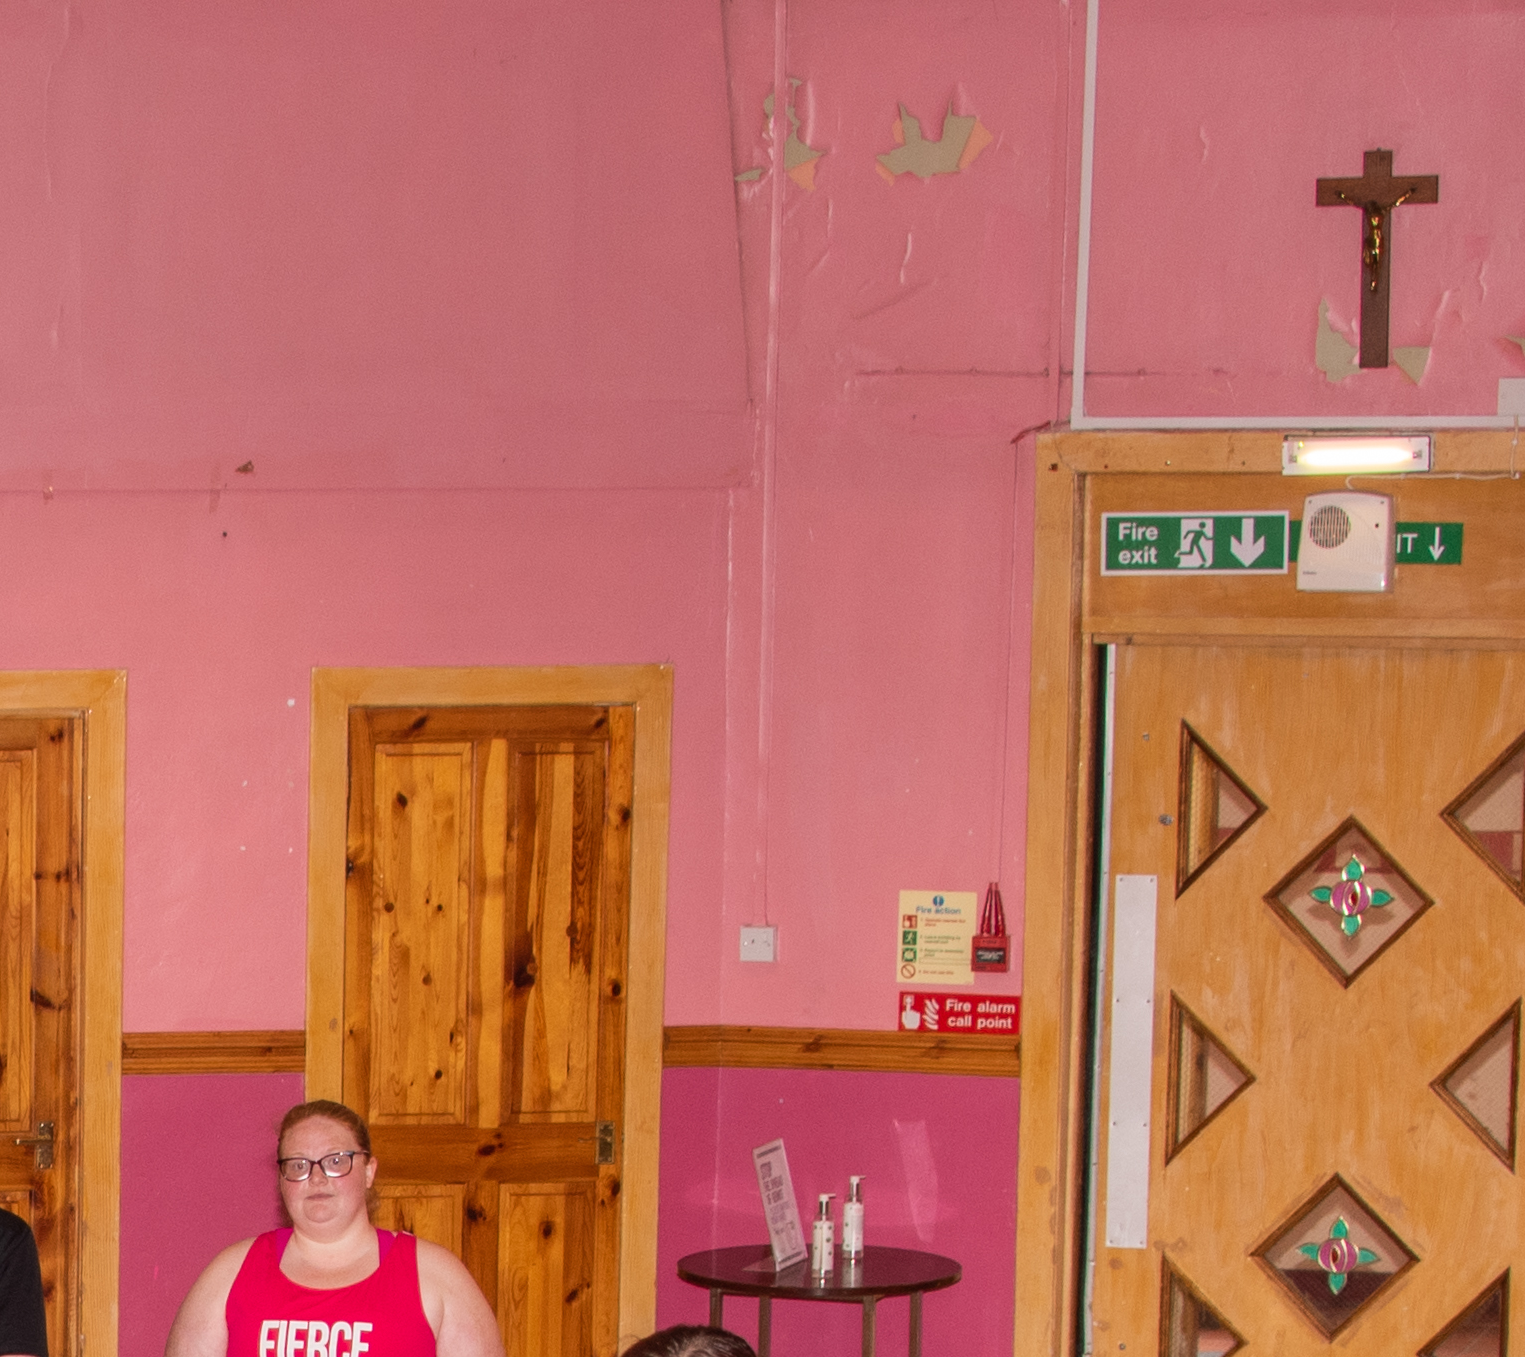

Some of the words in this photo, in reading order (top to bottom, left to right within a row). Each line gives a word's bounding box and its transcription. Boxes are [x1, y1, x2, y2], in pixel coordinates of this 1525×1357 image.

[1118, 522, 1158, 541] Fire
[1396, 534, 1418, 554] IT
[1118, 547, 1158, 564] exit
[916, 906, 932, 914] Fire
[945, 999, 971, 1012] Fire
[977, 1001, 1015, 1014] alarm
[947, 1015, 971, 1027] call
[977, 1017, 1012, 1029] point
